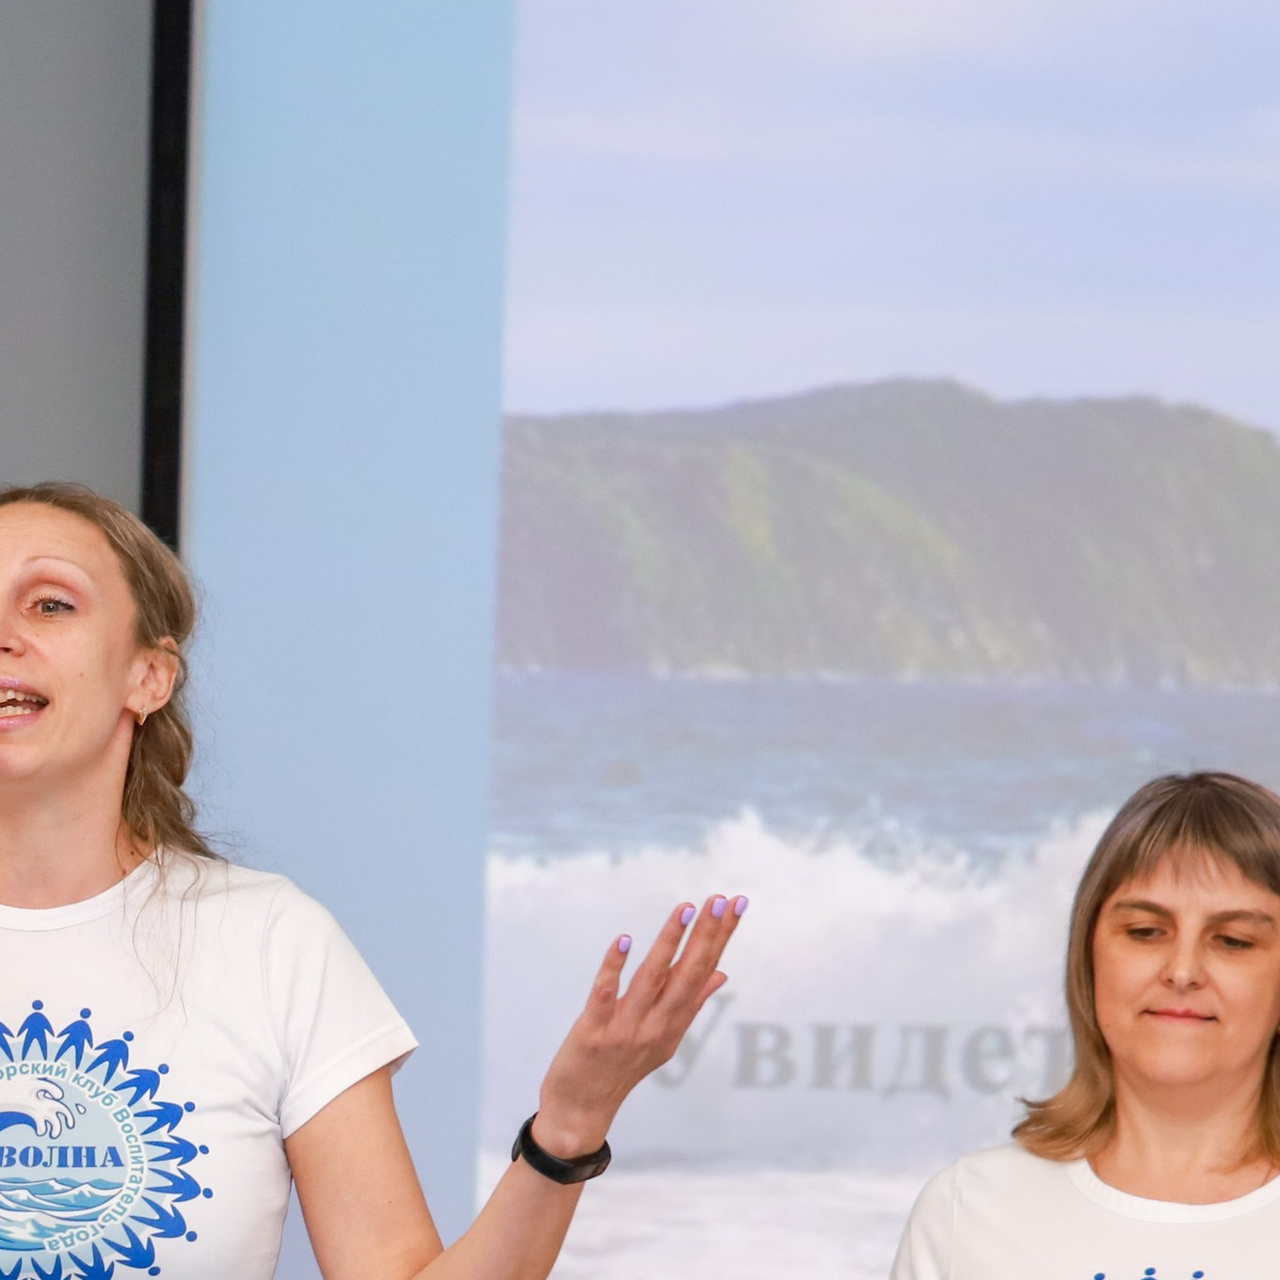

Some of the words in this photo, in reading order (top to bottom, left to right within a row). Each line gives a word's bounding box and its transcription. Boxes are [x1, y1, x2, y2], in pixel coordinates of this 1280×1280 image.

[72, 1072, 116, 1107] клуб
[101, 1108, 144, 1224] Воспитатель
[47, 1225, 101, 1252] года
